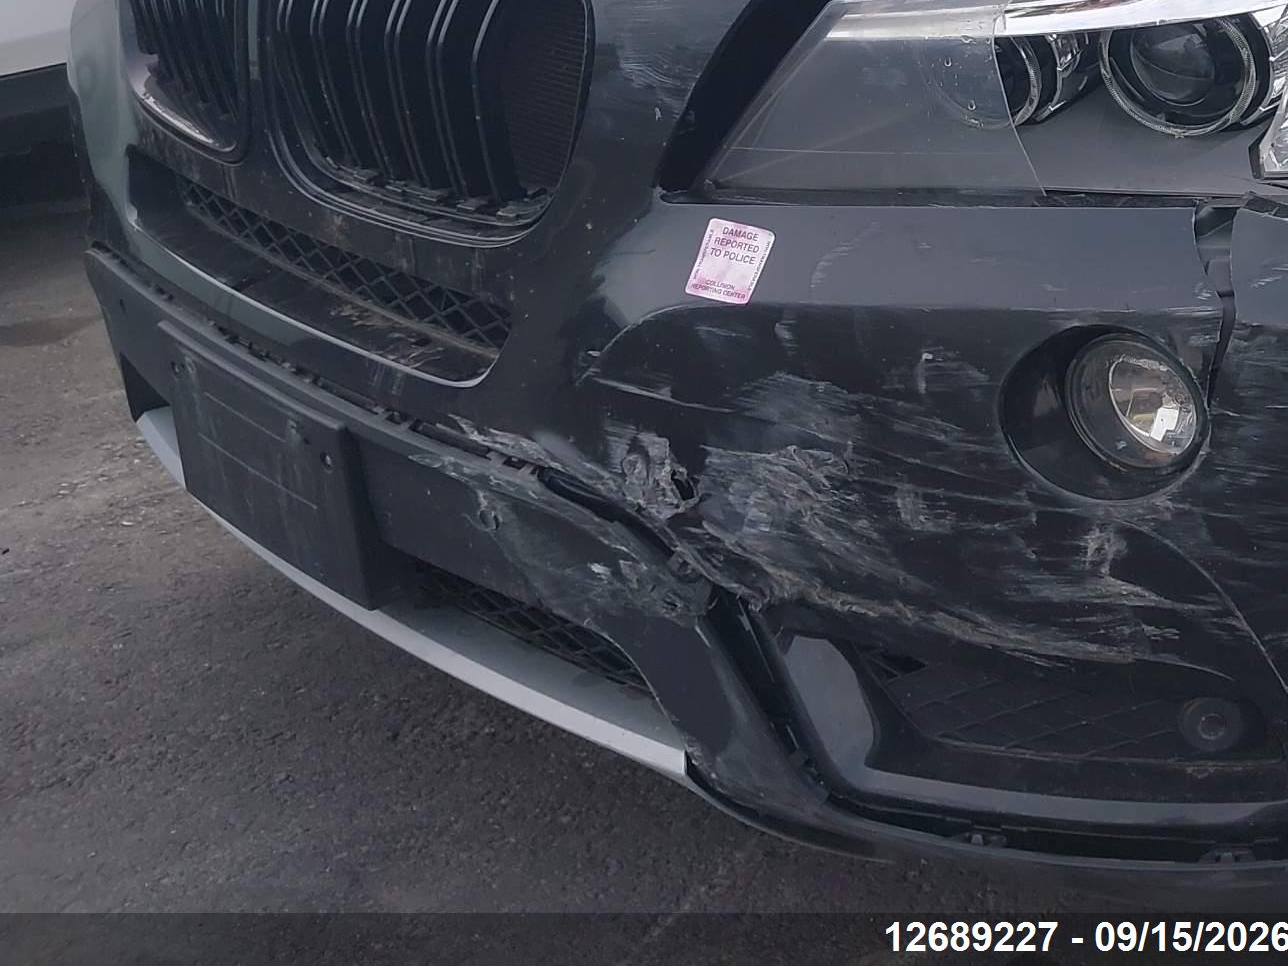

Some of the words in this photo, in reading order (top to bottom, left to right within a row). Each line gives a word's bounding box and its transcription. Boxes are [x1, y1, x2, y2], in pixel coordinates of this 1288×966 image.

[722, 226, 759, 242] DAMAGE
[713, 236, 760, 253] REPORTED
[710, 247, 722, 257] TO
[723, 250, 757, 265] POLICE
[691, 282, 722, 294] REPORTING
[722, 289, 746, 299] CENTER
[705, 279, 735, 291] COLLISION
